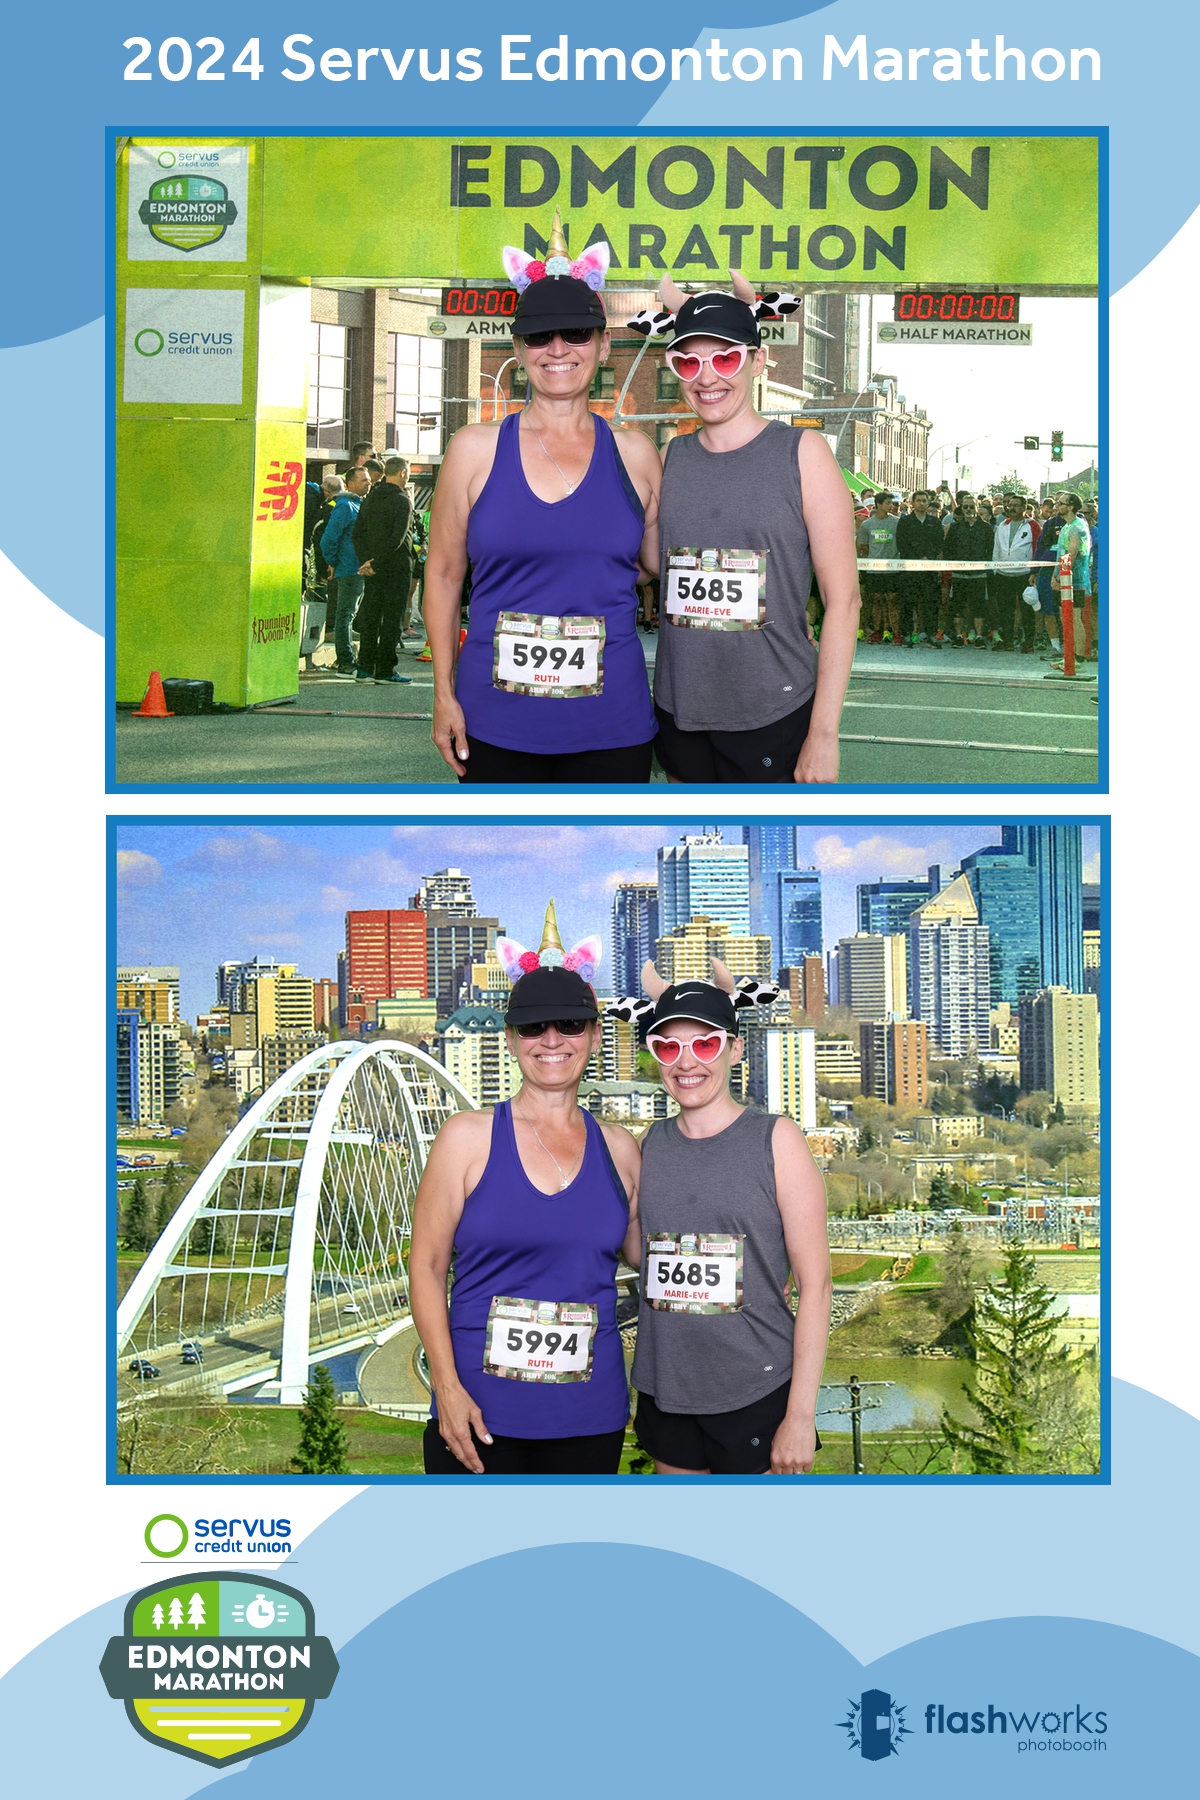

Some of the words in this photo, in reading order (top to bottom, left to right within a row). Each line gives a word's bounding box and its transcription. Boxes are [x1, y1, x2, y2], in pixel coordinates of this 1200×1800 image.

[178, 152, 220, 161] servus
[450, 144, 990, 211] EDMONTON
[149, 203, 227, 213] EDMONTON
[160, 214, 215, 222] MARATHON
[523, 223, 907, 270] MARATHON
[168, 332, 233, 344] servus
[900, 328, 939, 339] HALF
[943, 329, 1030, 340] MARATHON
[168, 345, 200, 354] credit
[203, 347, 232, 355] union
[677, 577, 742, 603] 5685
[684, 605, 731, 616] MARIE-EVE
[710, 619, 723, 627] 10K
[513, 643, 585, 670] 5994
[534, 674, 560, 683] RUTH
[529, 686, 549, 694] ARMY
[551, 687, 564, 695] 10K
[657, 1261, 720, 1287] 5685
[664, 1290, 709, 1299] MARIE-EVE
[689, 1303, 702, 1311] 10K
[507, 1327, 578, 1356] 5994
[527, 1359, 553, 1368] RUTH
[521, 1371, 542, 1379] ARMY
